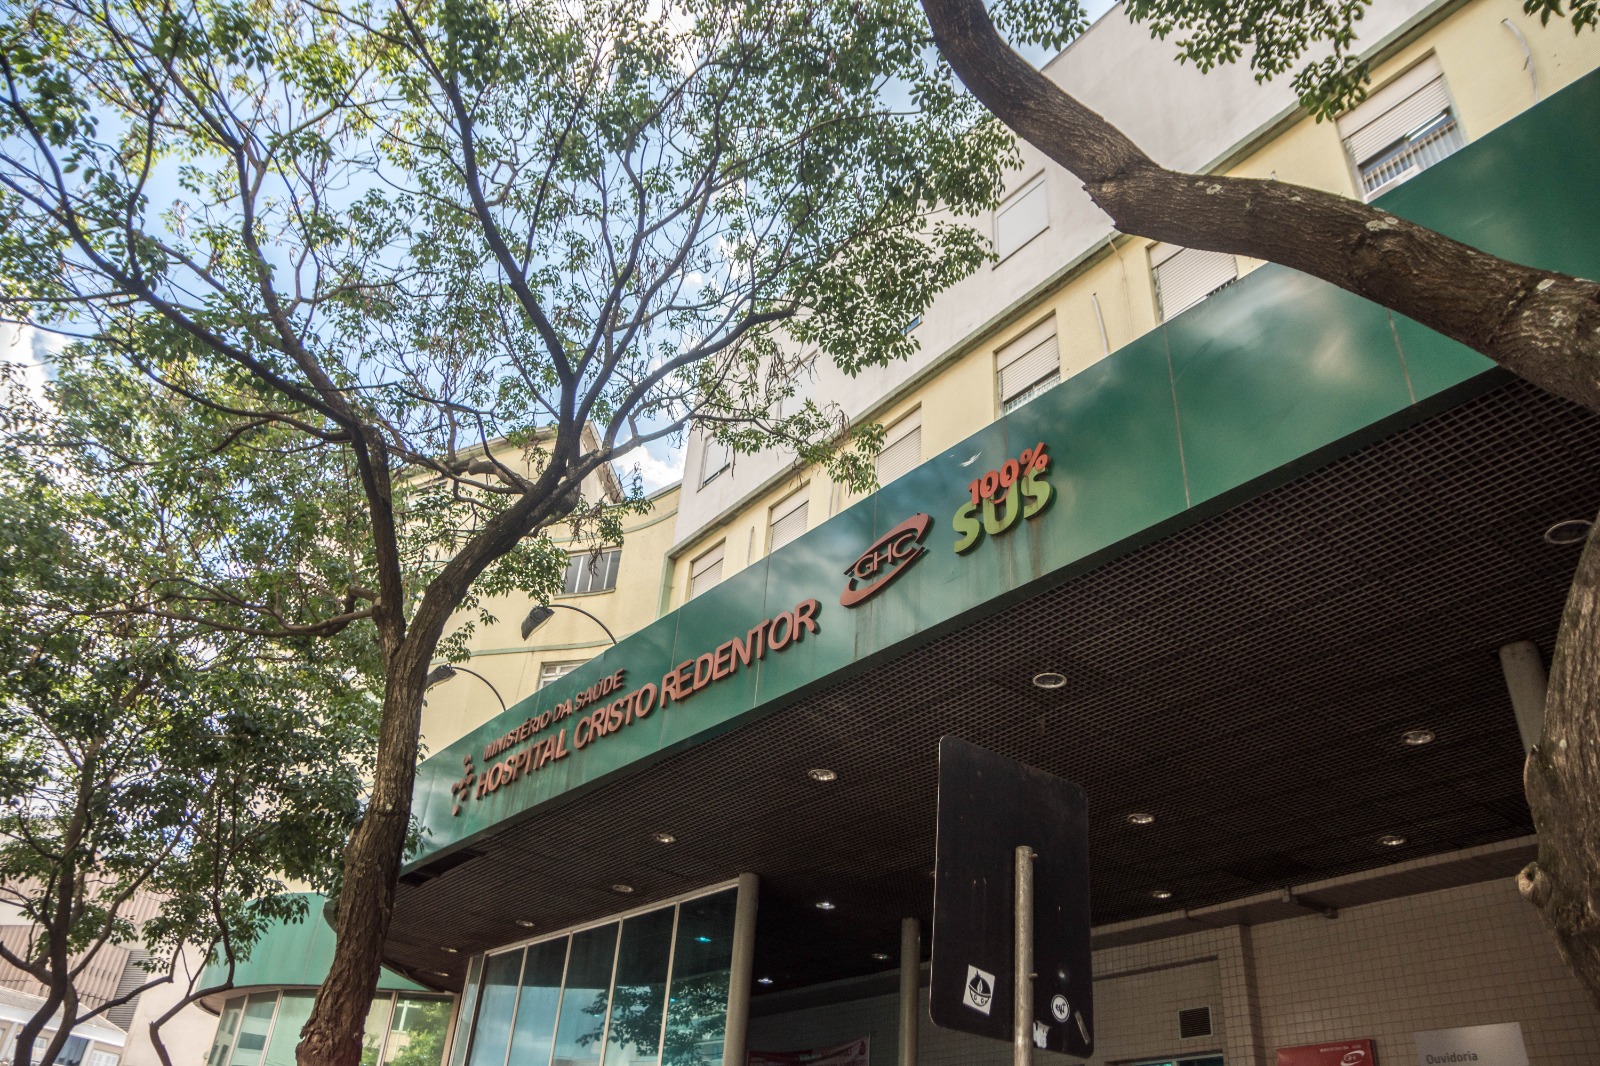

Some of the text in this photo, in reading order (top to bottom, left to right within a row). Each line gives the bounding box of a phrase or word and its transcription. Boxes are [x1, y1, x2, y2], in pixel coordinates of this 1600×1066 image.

[952, 467, 1054, 554] SUS
[968, 442, 1050, 505] 100%
[853, 532, 916, 578] GHC
[476, 598, 820, 799] HOSPITAL CRISTO REDENTOR
[483, 668, 626, 761] MINISTÉRIO DA SAÚDE
[1426, 1051, 1478, 1065] Ouvidoria
